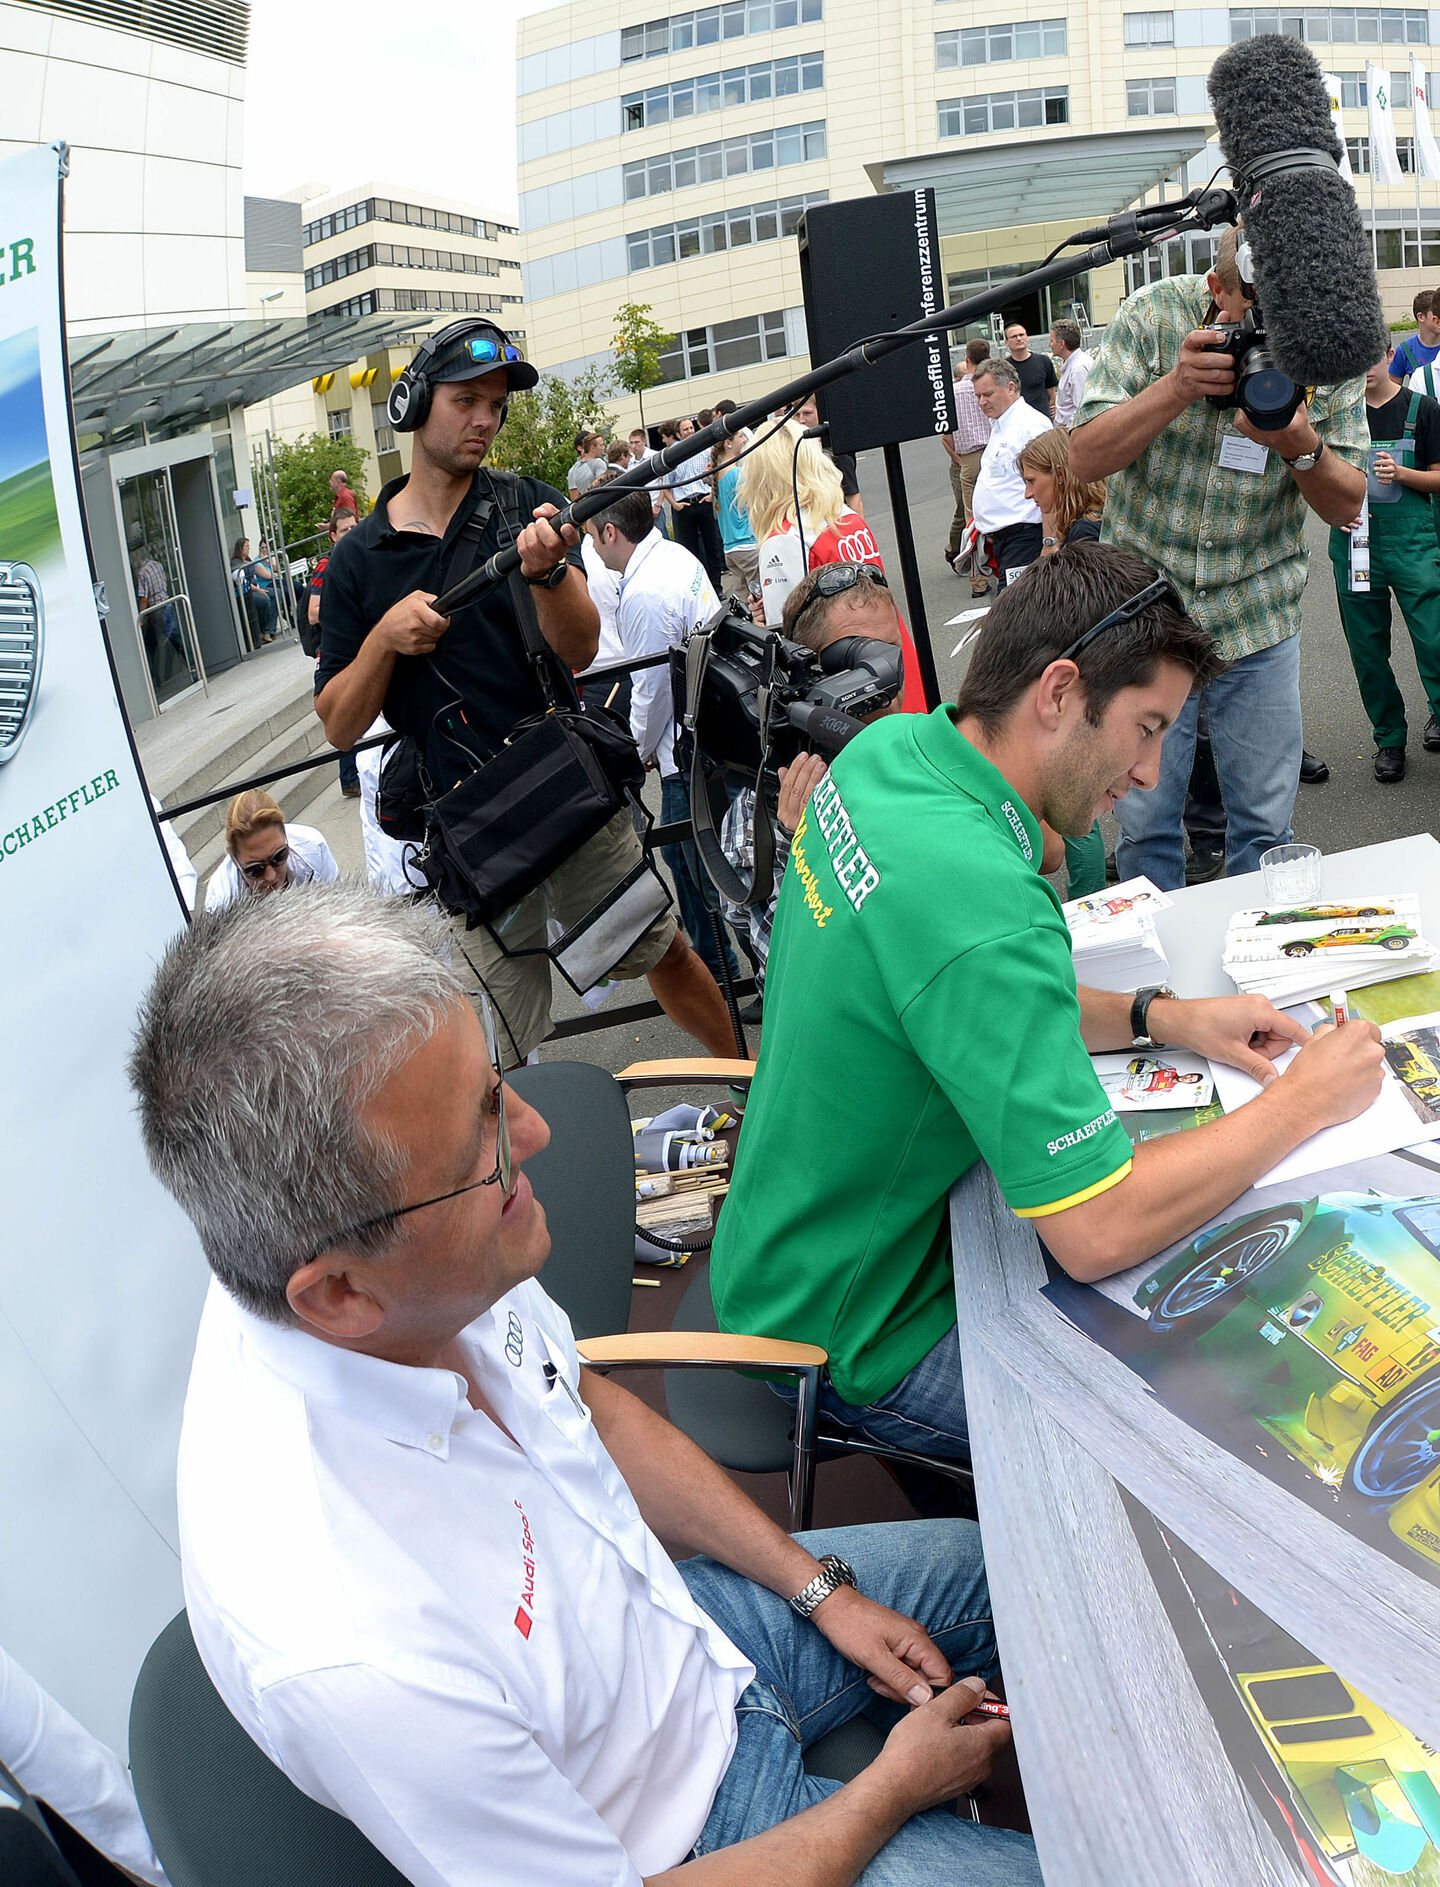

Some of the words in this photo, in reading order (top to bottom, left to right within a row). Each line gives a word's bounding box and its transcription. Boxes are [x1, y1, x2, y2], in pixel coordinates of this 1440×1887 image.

[913, 188, 939, 343] Knferenzzentrum
[927, 341, 950, 435] Schaeffler
[841, 691, 857, 702] SONY
[520, 1554, 536, 1610] Audi
